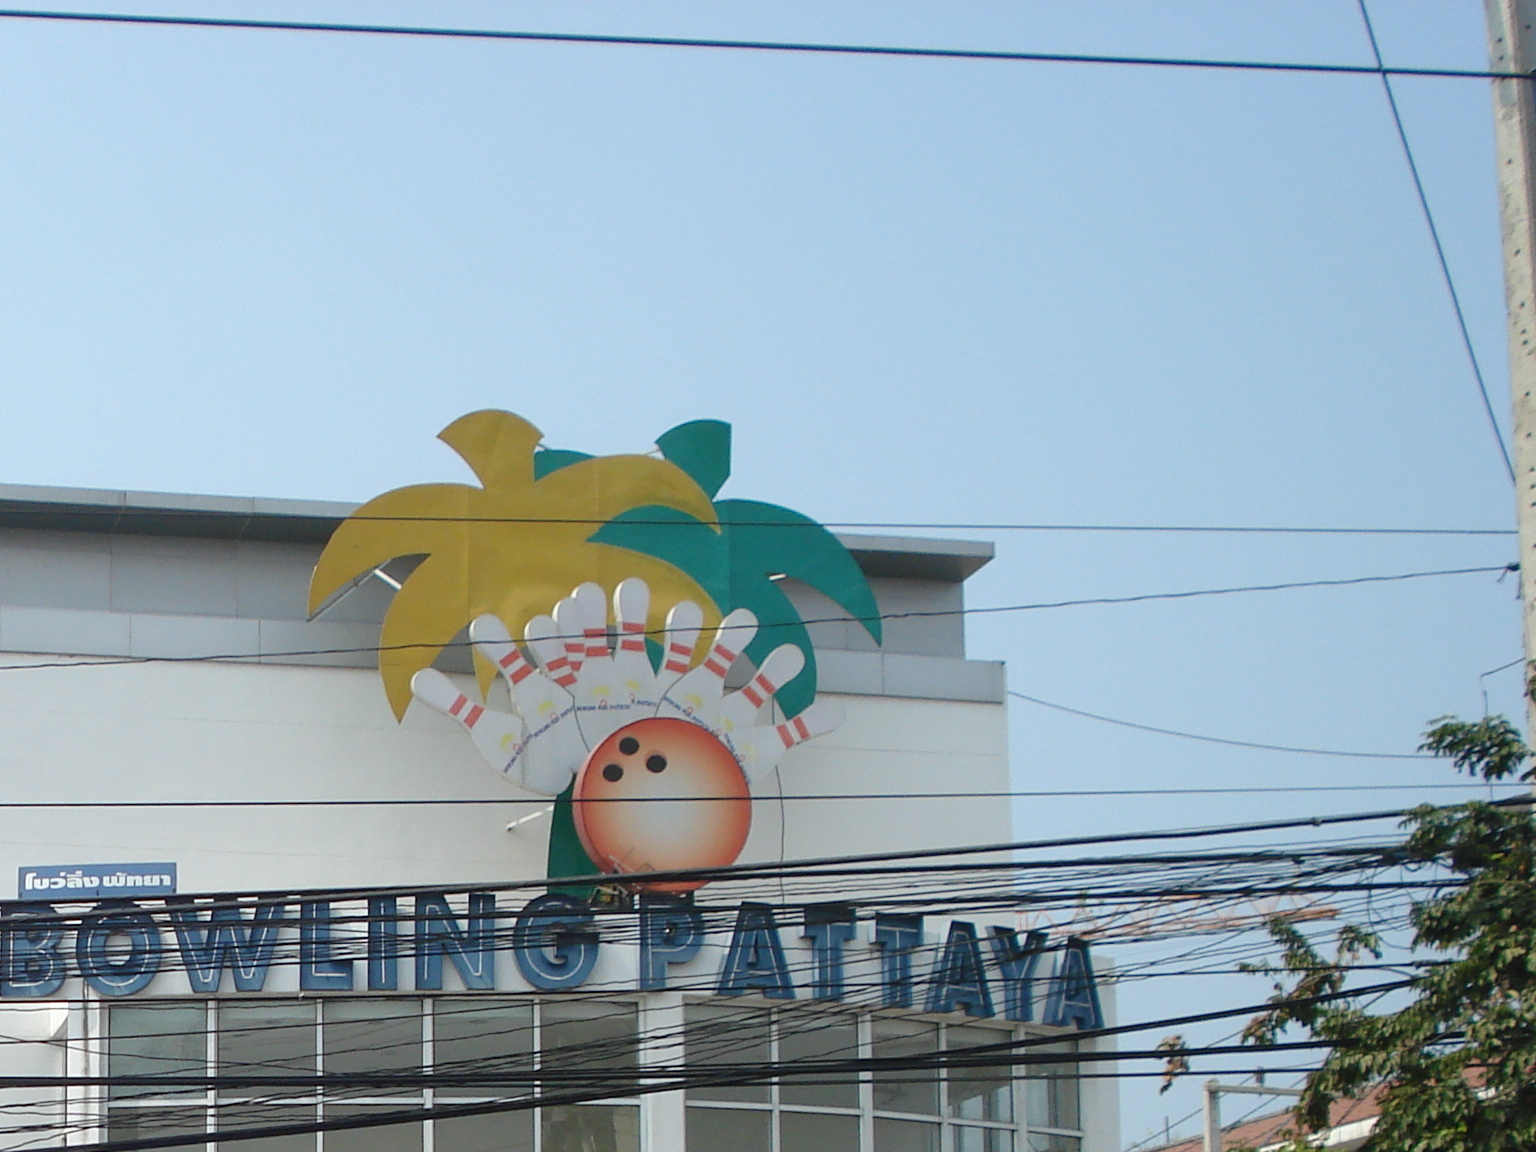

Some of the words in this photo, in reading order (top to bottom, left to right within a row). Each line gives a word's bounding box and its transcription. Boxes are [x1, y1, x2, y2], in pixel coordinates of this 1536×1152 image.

[103, 871, 172, 888] พัทยา
[0, 893, 600, 997] BOWLING
[639, 892, 1104, 1030] PATTAYA
